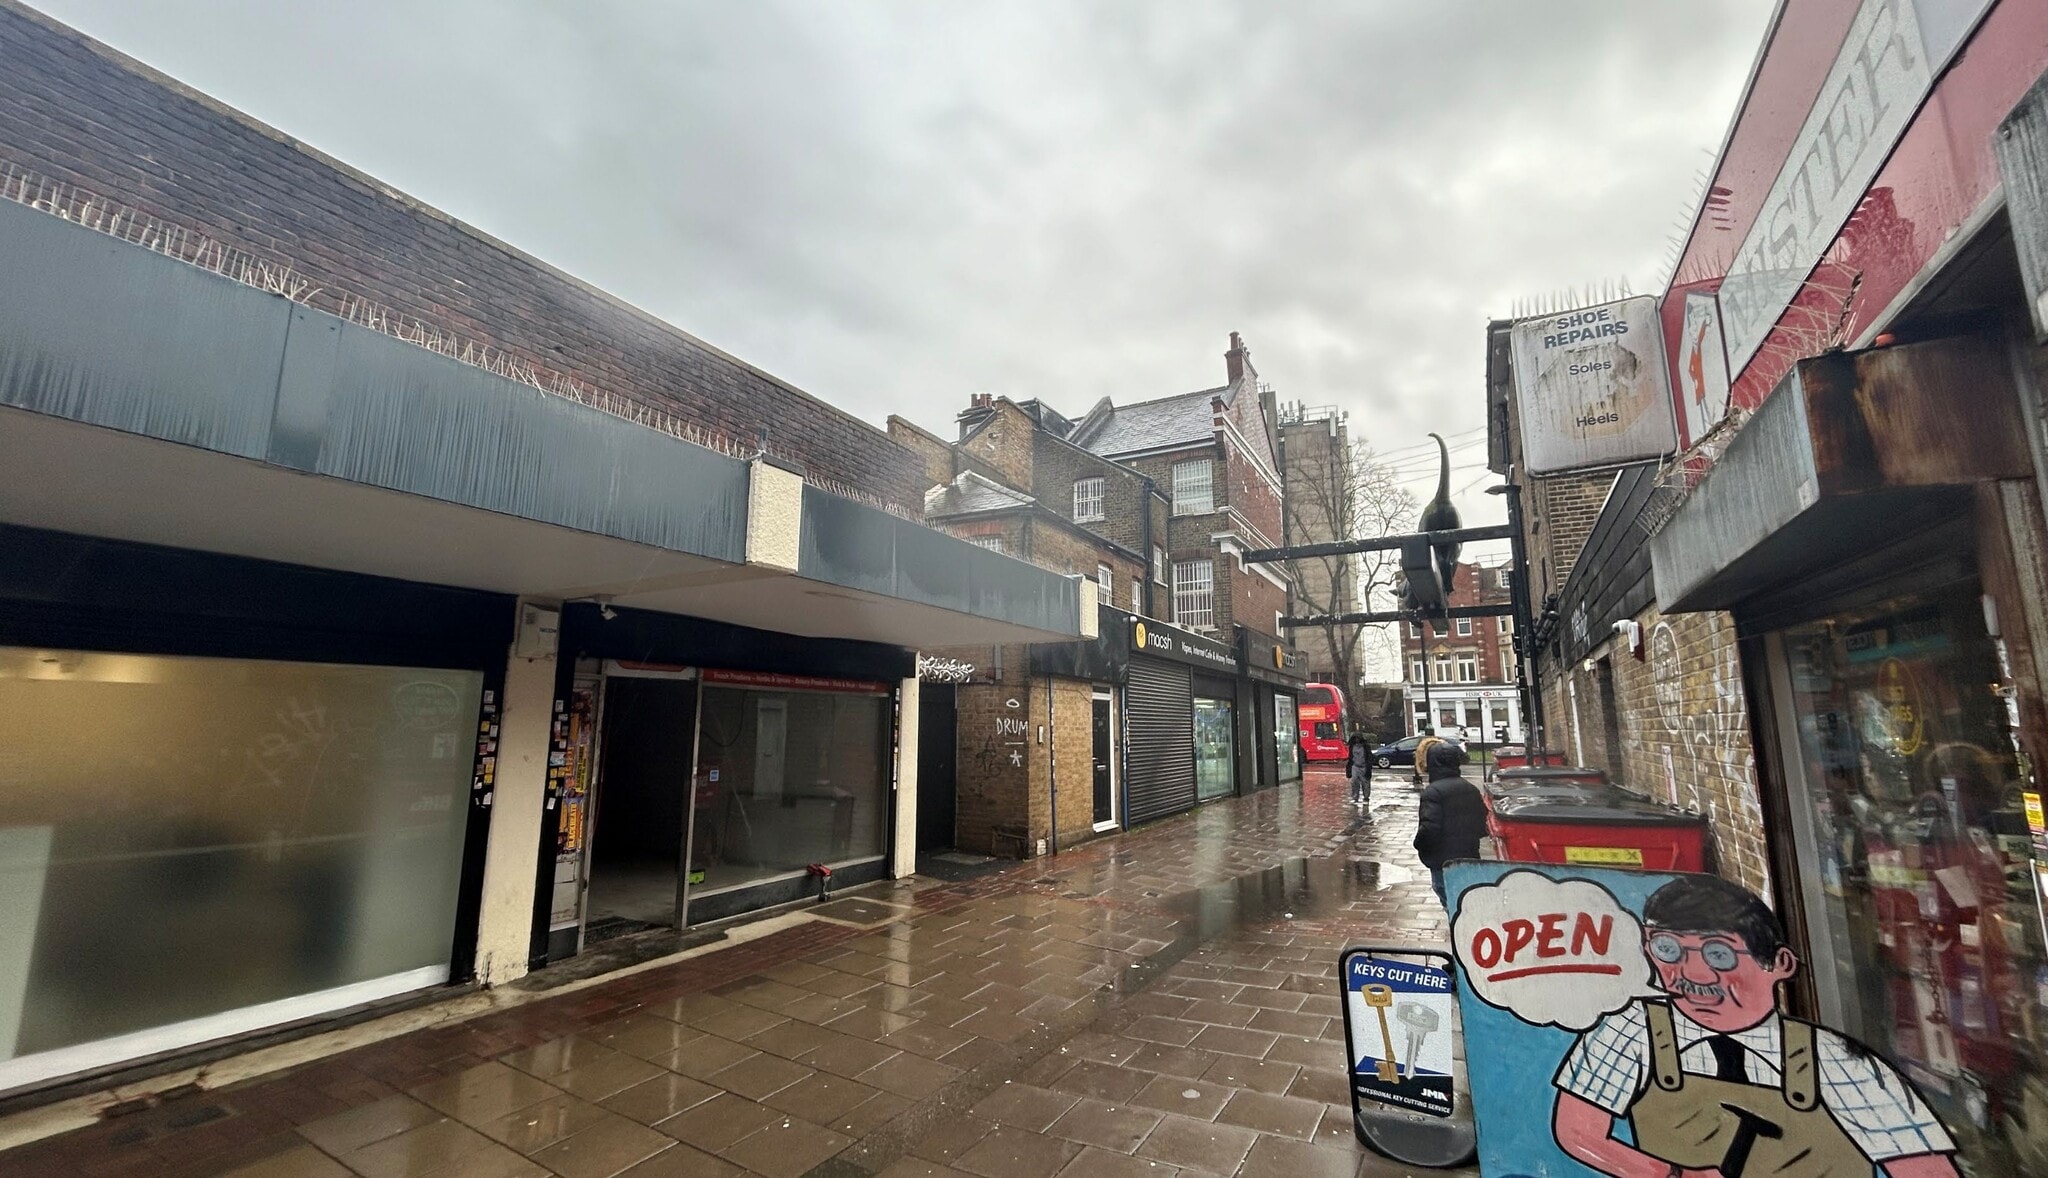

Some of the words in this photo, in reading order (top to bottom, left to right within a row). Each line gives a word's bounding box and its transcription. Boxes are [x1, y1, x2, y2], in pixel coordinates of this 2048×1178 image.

[1725, 0, 1915, 354] MISTER
[1557, 308, 1610, 330] SHOE
[1544, 321, 1629, 349] REPAIRS
[1569, 360, 1612, 376] Soles
[1576, 412, 1619, 428] Heels
[1148, 632, 1172, 651] mocsh
[996, 717, 1029, 740] DRUM
[1471, 911, 1614, 969] OPEN
[1353, 962, 1385, 979] KEYS
[1387, 967, 1413, 983] CUT
[1414, 971, 1447, 989] HERE
[1392, 1094, 1403, 1102] KEY
[1403, 1097, 1427, 1107] CUTTING
[1428, 1102, 1451, 1114] SERVICE
[1420, 1087, 1448, 1102] JMA
